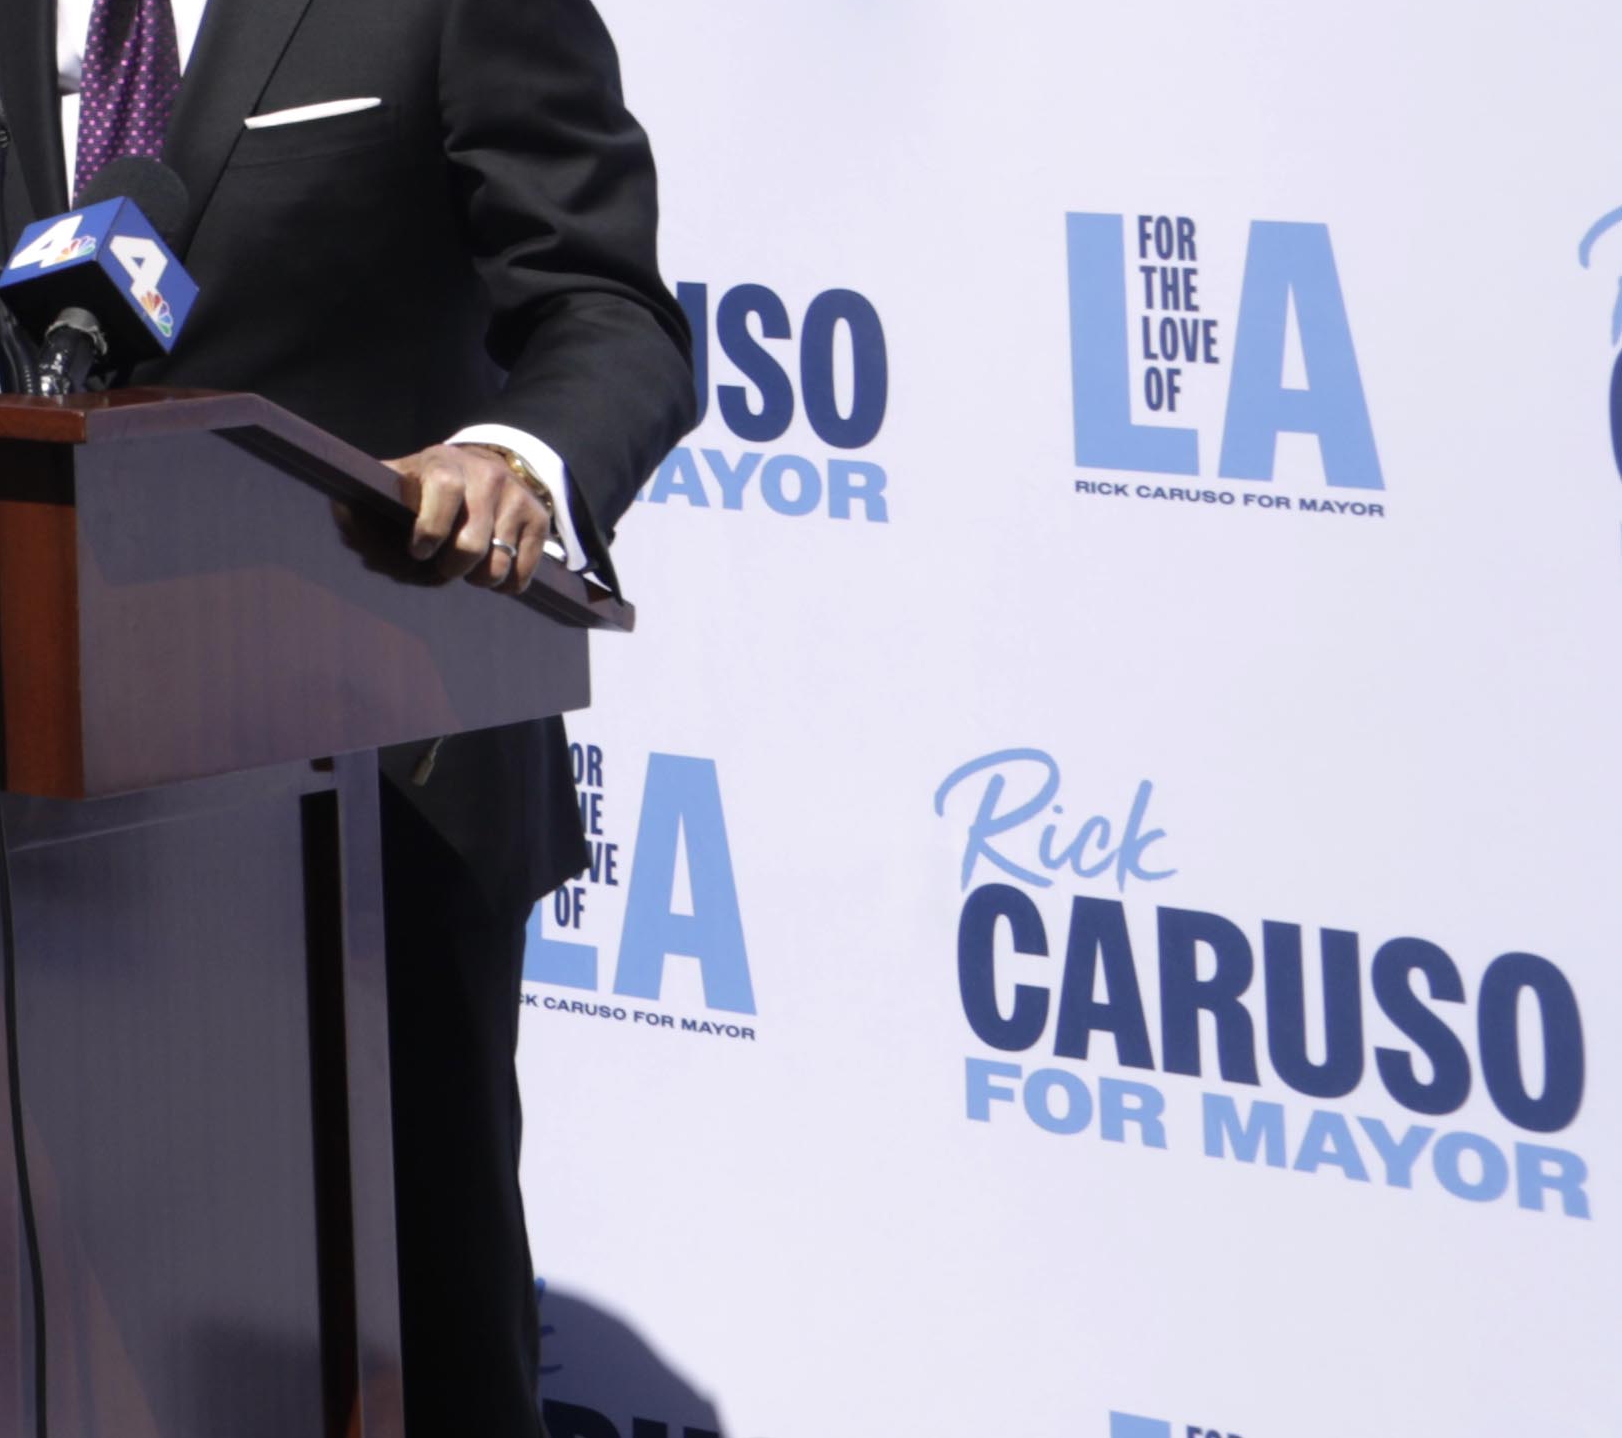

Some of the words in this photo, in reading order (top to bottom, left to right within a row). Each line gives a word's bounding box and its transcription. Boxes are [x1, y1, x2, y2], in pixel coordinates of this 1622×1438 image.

[8, 214, 82, 269] 4
[1139, 215, 1197, 263] FOR
[109, 236, 168, 299] 4
[1140, 266, 1199, 312] THE
[1065, 210, 1386, 492] LA
[1142, 316, 1219, 364] LOVE
[1144, 365, 1183, 412] OF
[1075, 479, 1130, 499] RICK
[1135, 484, 1235, 508] CARUSO
[1243, 492, 1294, 511] FOR
[1300, 497, 1386, 519] MAYOR
[934, 748, 1181, 897] Rick
[956, 882, 1587, 1134] CARUSO
[963, 1056, 1169, 1151] FOR
[1203, 1091, 1593, 1220] MAYOR
